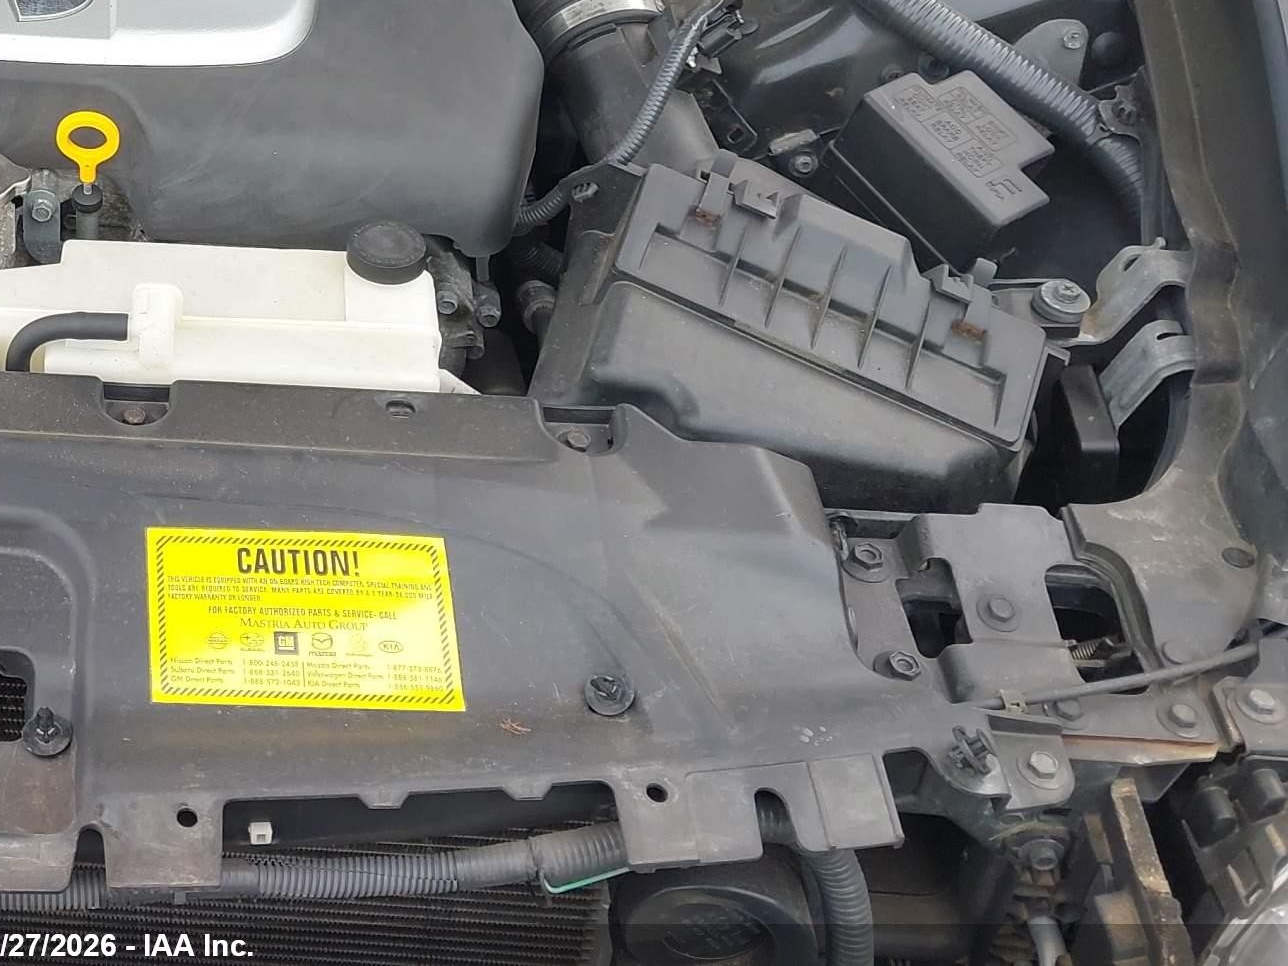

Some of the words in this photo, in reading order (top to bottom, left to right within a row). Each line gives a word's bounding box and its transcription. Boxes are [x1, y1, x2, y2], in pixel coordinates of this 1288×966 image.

[237, 547, 360, 576] CAUTION!
[167, 575, 181, 583] THIS
[182, 575, 205, 583] VEHICLE
[213, 577, 241, 585] EQUIPPED
[315, 579, 330, 587] TECH
[201, 585, 231, 594] REQUIRED
[292, 587, 311, 595] PARTS
[326, 588, 353, 596] COVERED
[167, 593, 193, 601] FACTORY
[193, 593, 227, 602] WARRANTY
[208, 605, 222, 615] FOR
[224, 606, 256, 616] FACTORY
[259, 607, 305, 617] AUTHORIZED
[307, 608, 332, 617] PARTS
[333, 609, 340, 618] &
[378, 611, 398, 621] CALL
[278, 635, 295, 648] GM
[382, 642, 400, 651] KIA
[170, 675, 183, 683] GM
